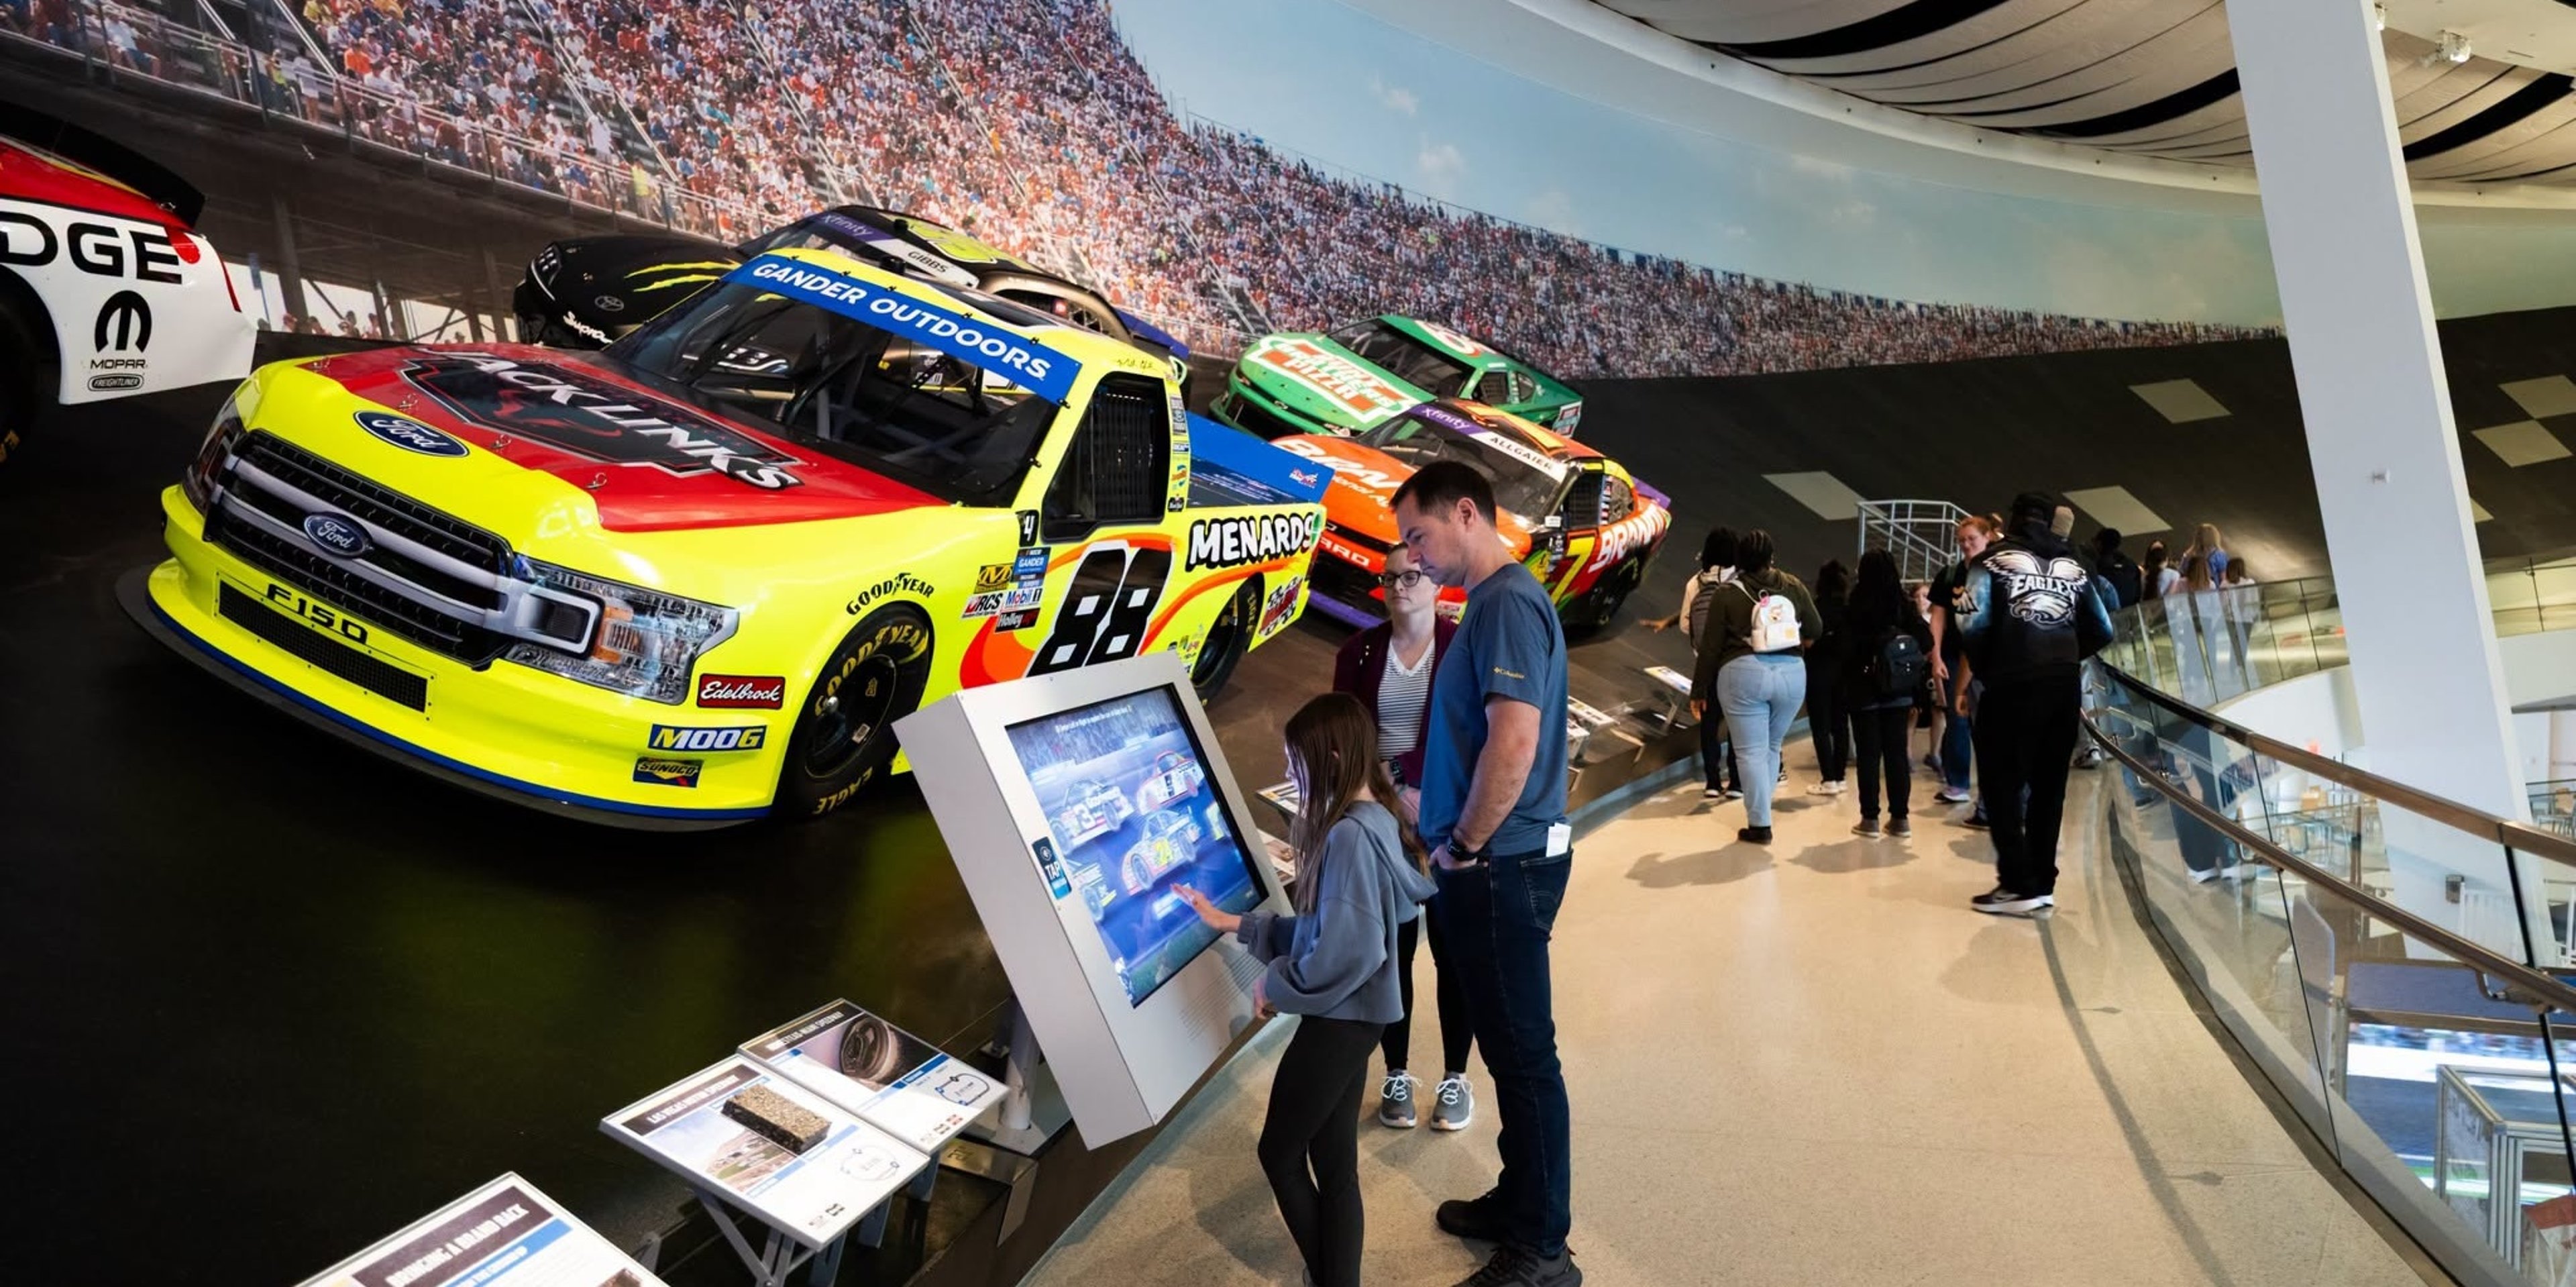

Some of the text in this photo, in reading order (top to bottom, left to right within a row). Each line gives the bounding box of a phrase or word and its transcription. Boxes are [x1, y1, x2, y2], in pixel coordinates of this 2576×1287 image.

[822, 215, 873, 236] xfinity
[908, 252, 949, 272] GIBBS
[753, 262, 1052, 379] GANDER OUTDOORS
[90, 359, 146, 370] MOPAR
[1282, 358, 1360, 401] PIZZA
[1421, 409, 1472, 429] xfinity
[372, 415, 447, 449] Ford
[1490, 437, 1552, 469] ALLGAIER
[317, 521, 355, 549] Ford
[1187, 511, 1316, 568] MENARDS
[846, 572, 934, 615] GOODYEAR
[2010, 574, 2077, 605] EAGLES
[1026, 545, 1173, 678] 88
[700, 680, 782, 702] Edelbrock
[652, 727, 764, 750] MOOG
[638, 760, 696, 777] SUNOCO
[1044, 861, 1061, 880] TAP
[646, 1111, 667, 1124] LAS
[492, 1204, 530, 1227] BACK
